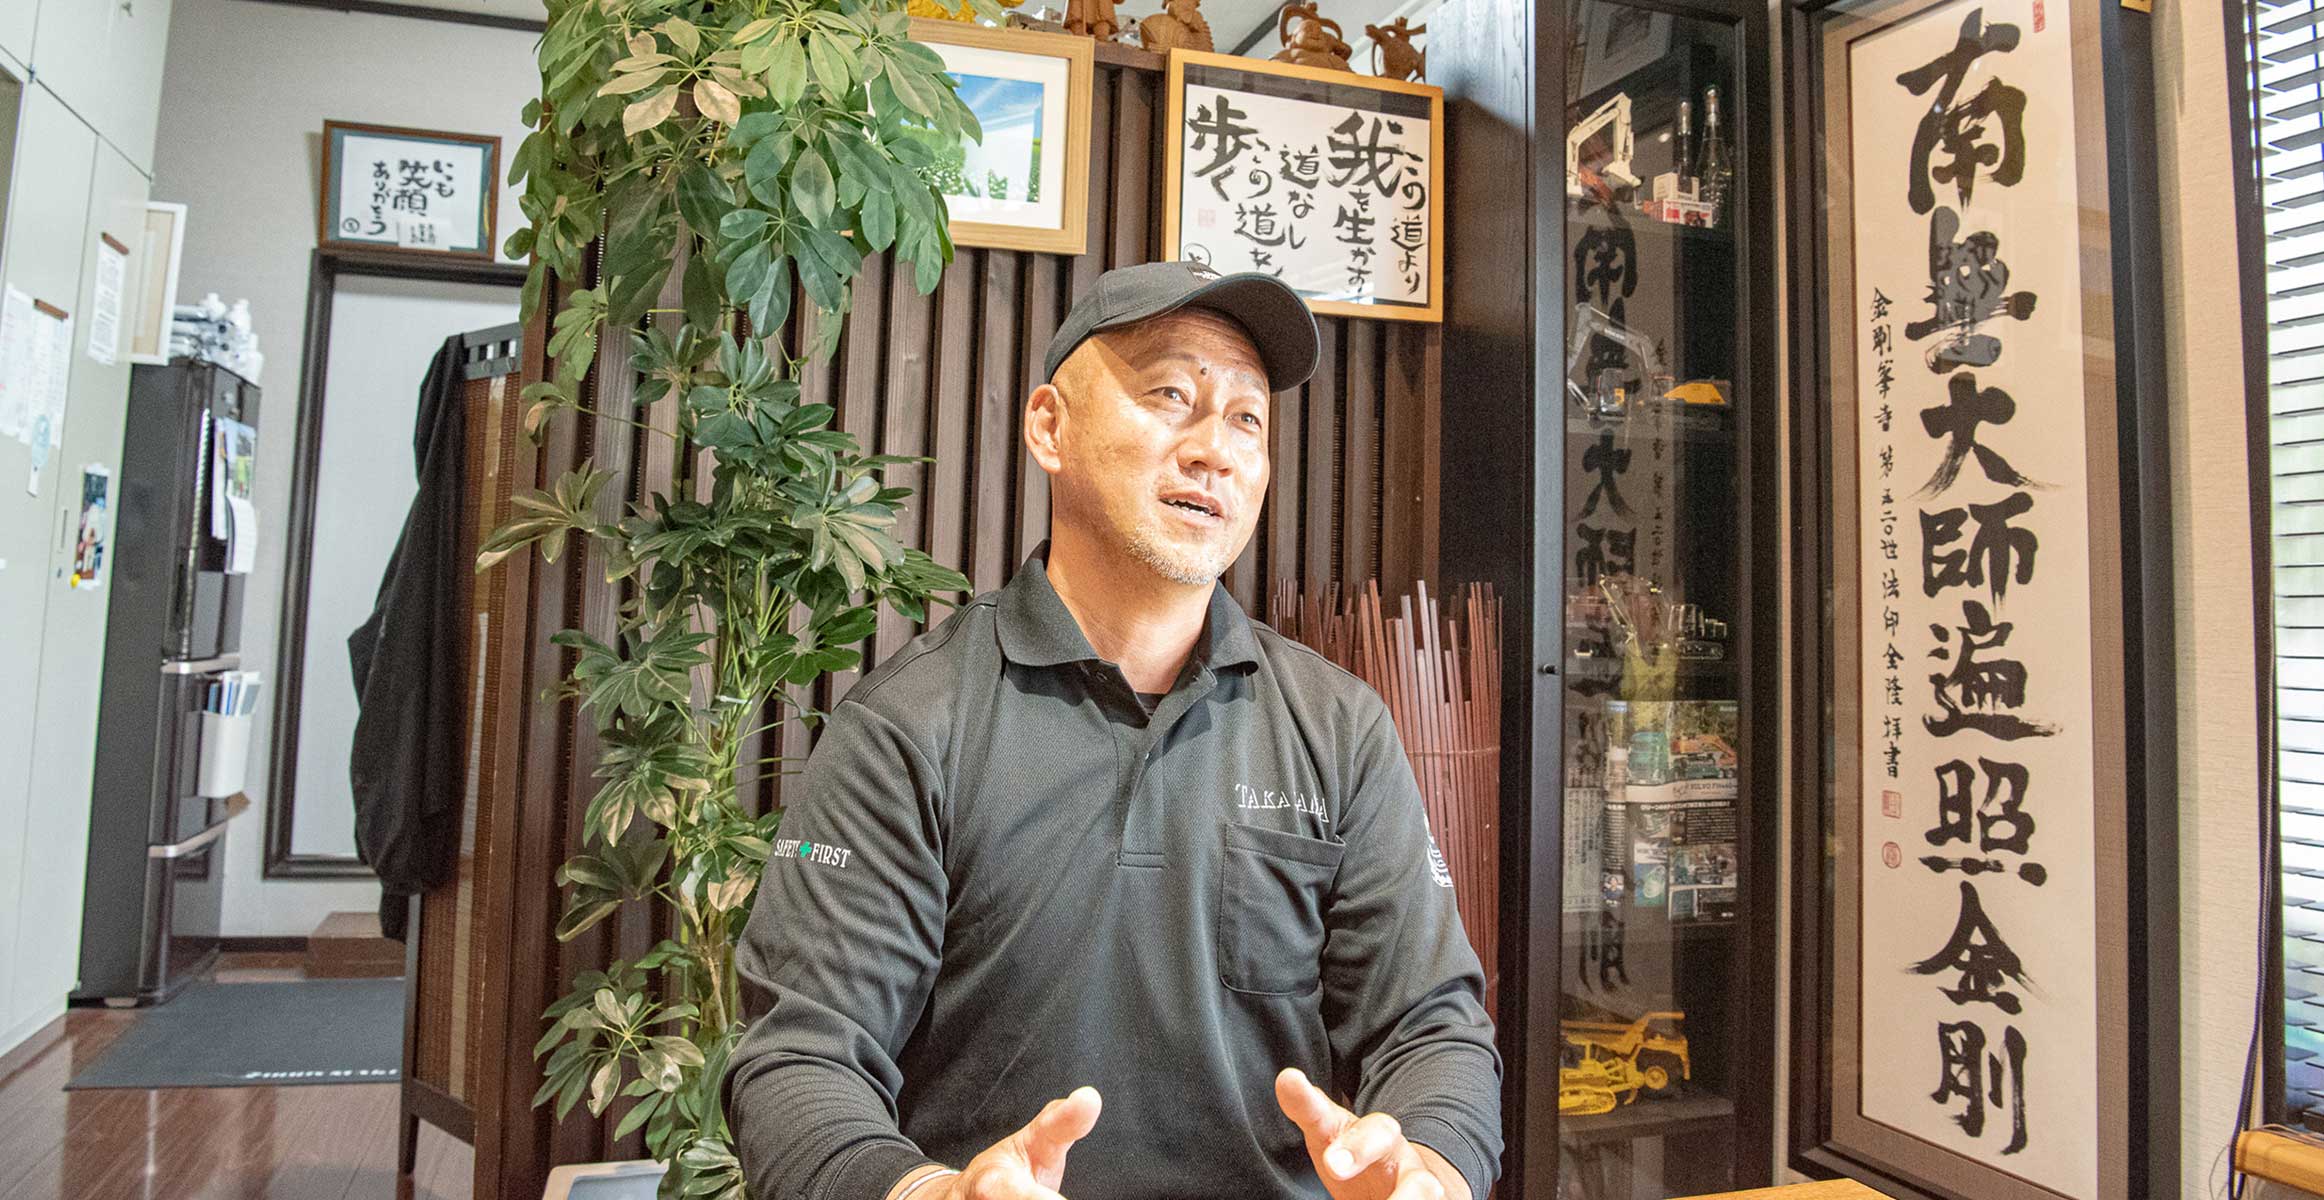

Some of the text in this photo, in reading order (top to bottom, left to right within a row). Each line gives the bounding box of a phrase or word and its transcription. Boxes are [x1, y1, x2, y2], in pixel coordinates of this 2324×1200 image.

[365, 160, 391, 236] ありがとう
[392, 159, 432, 217] 笑顔
[1185, 94, 1258, 202] 歩く
[1278, 145, 1321, 249] 道なし
[1326, 111, 1406, 293] 我を生かす
[1391, 151, 1427, 295] この道より
[1896, 7, 2065, 1156] 南無大師遍照金剛
[810, 843, 851, 868] FIRST
